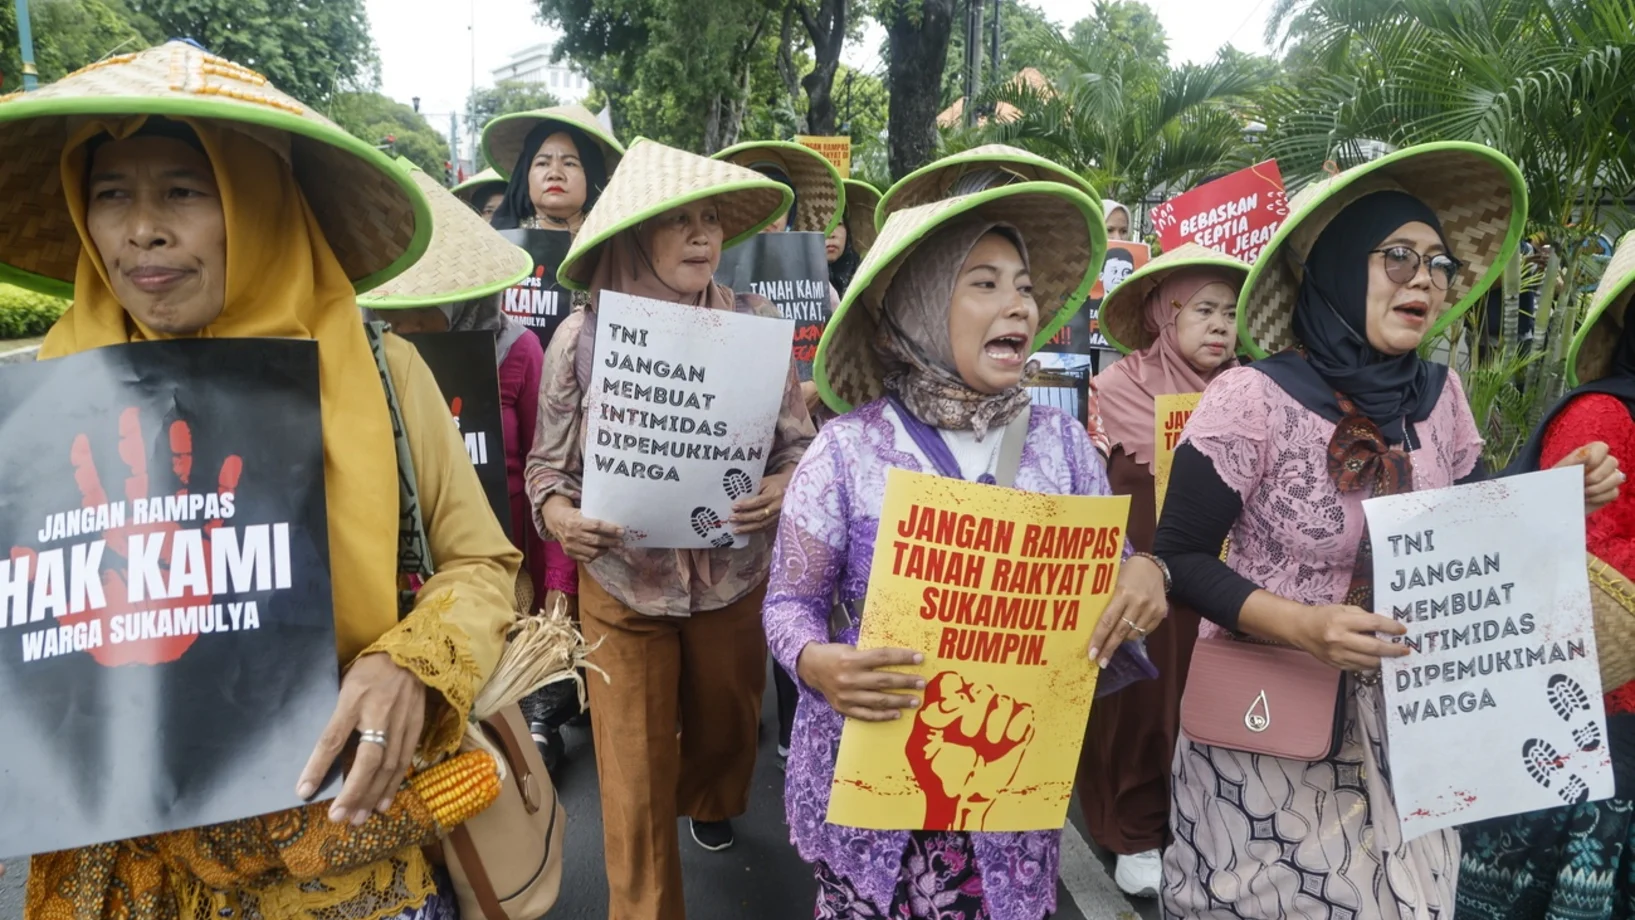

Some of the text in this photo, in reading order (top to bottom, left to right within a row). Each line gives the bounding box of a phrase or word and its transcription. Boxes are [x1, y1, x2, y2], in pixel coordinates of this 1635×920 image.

[1180, 193, 1258, 237] BEBASKAN
[1194, 216, 1249, 247] SEPTIA
[1232, 221, 1279, 255] JERAT
[505, 287, 558, 316] KAMI
[750, 279, 825, 300] TANAH KAMI
[609, 323, 649, 348] TNI
[604, 351, 706, 383] JANGAN
[603, 377, 715, 411] MEMBUAT
[600, 403, 728, 437] INTIMIDAS
[597, 429, 763, 462] DIPEMUKIMAN
[595, 454, 680, 482] WARGA
[38, 492, 235, 542] JANGAN RAMPAS
[897, 504, 1120, 560] JANGAN RAMPAS
[1388, 530, 1435, 557] TNI
[0, 522, 292, 629] HAK KAMI
[892, 541, 1114, 595] TANAH RAKYAT DI
[1390, 552, 1500, 592] JANGAN
[919, 586, 1080, 631] SUKAMULYA
[1392, 582, 1515, 623] MEMBUAT
[22, 601, 260, 662] WARGA SUKAMULYA
[937, 627, 1048, 666] RUMPIN.
[1395, 638, 1586, 693] DIPEMUKIMAN
[1398, 688, 1497, 726] WARGA
